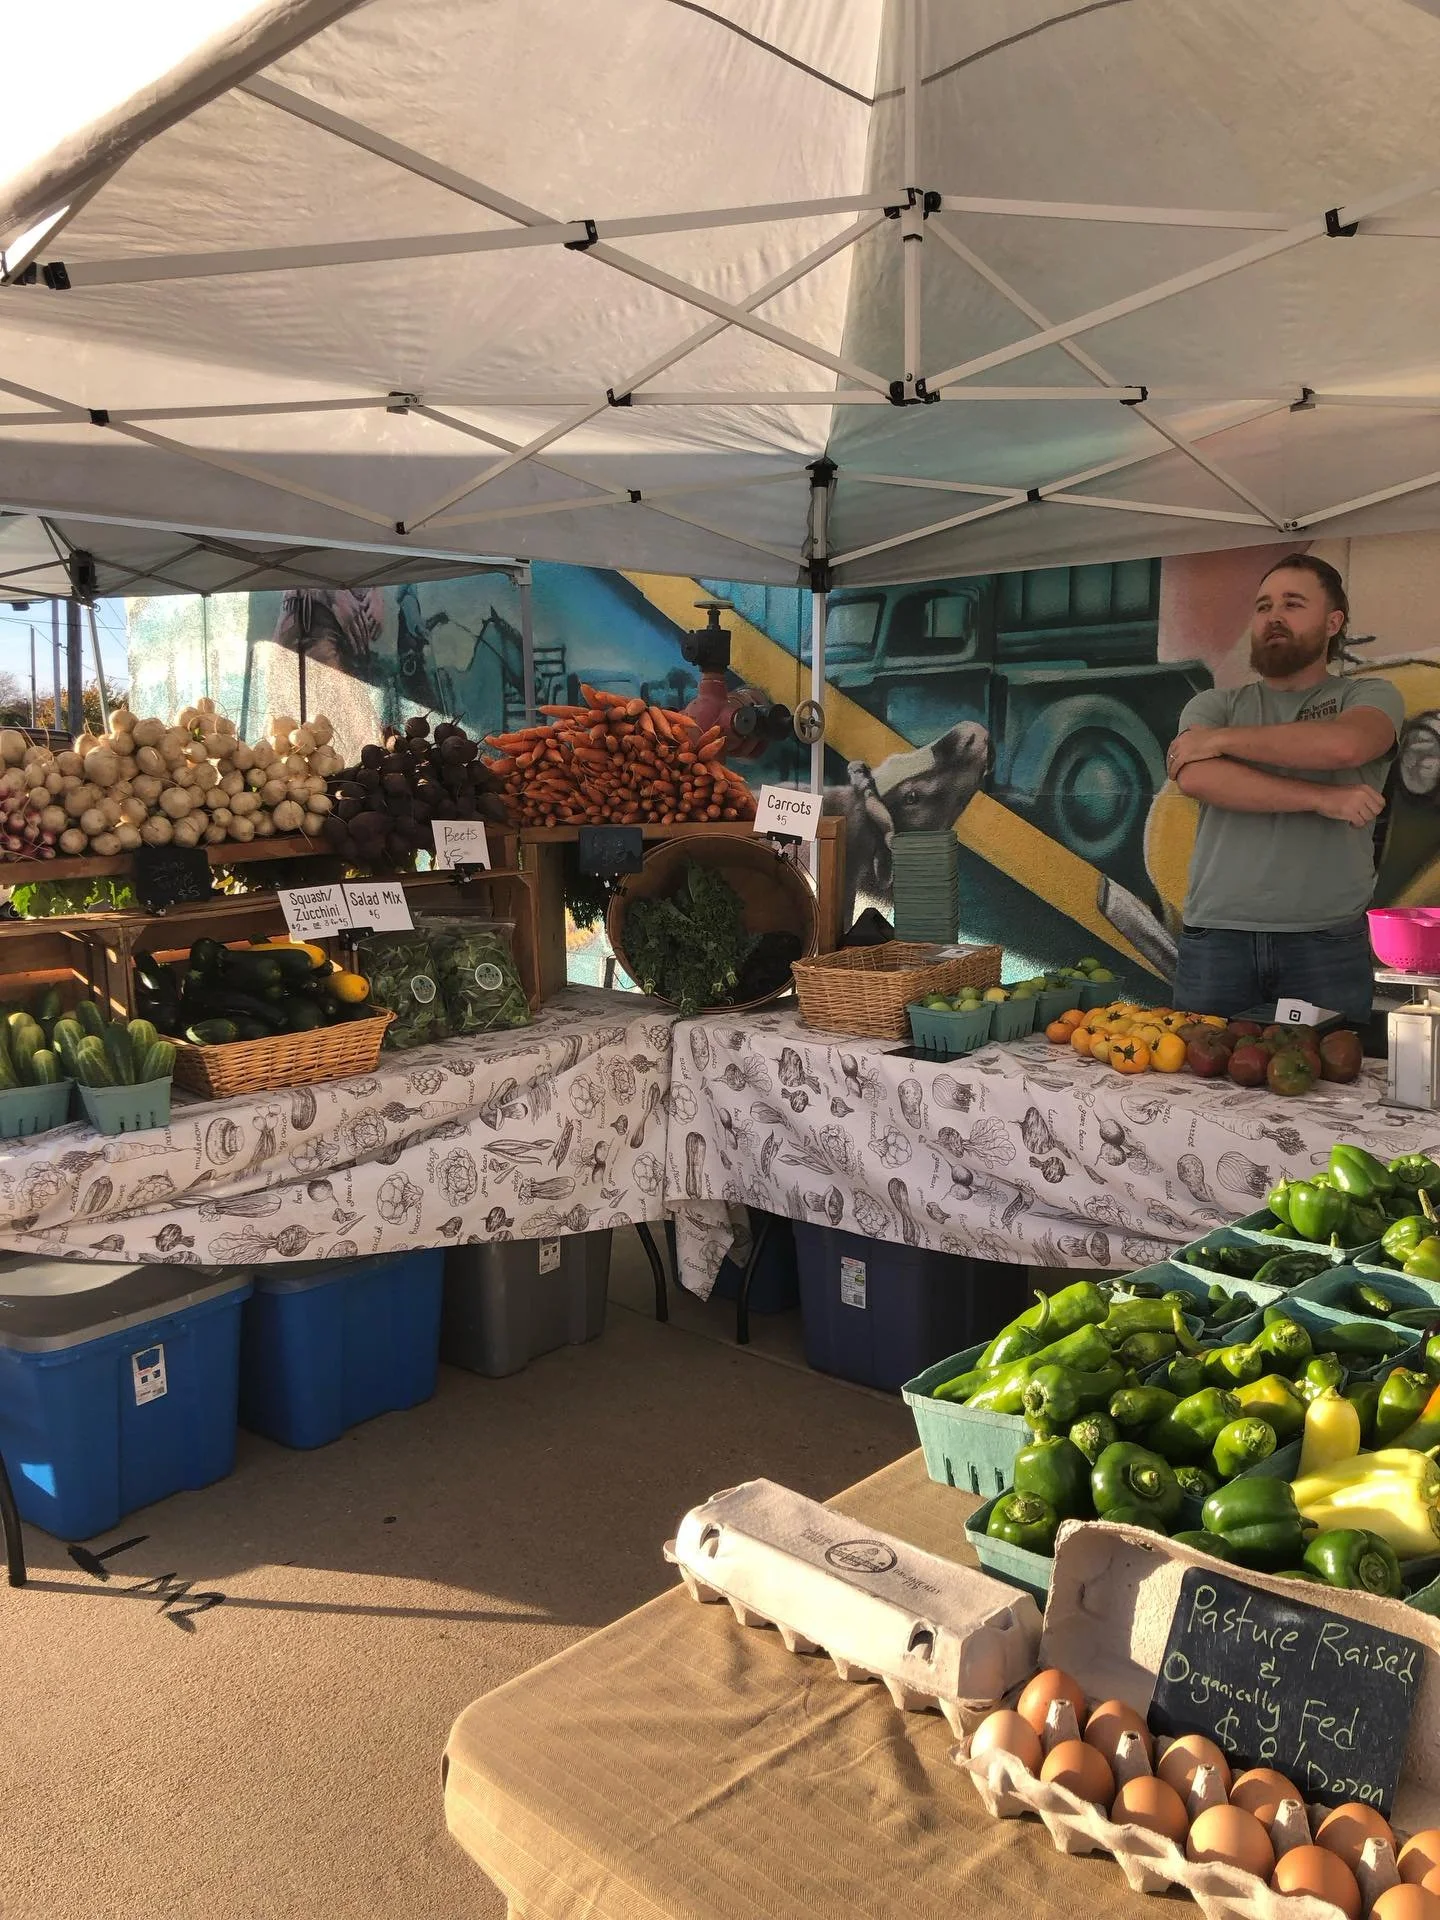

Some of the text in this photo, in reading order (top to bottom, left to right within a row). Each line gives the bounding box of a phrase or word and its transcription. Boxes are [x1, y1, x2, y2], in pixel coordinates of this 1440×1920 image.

[767, 794, 812, 815] Carrots
[776, 815, 788, 826] $5
[443, 826, 479, 845] Beets
[289, 888, 332, 909] Squash/
[350, 890, 403, 906] Salad Mix
[293, 904, 340, 922] Zucchini
[369, 909, 380, 920] $6
[193, 1121, 202, 1170] mushroom
[428, 1150, 440, 1184] cabbage
[1187, 1584, 1300, 1652] Pasture
[1258, 1656, 1281, 1687] &
[1163, 1651, 1361, 1751] Organically Fed
